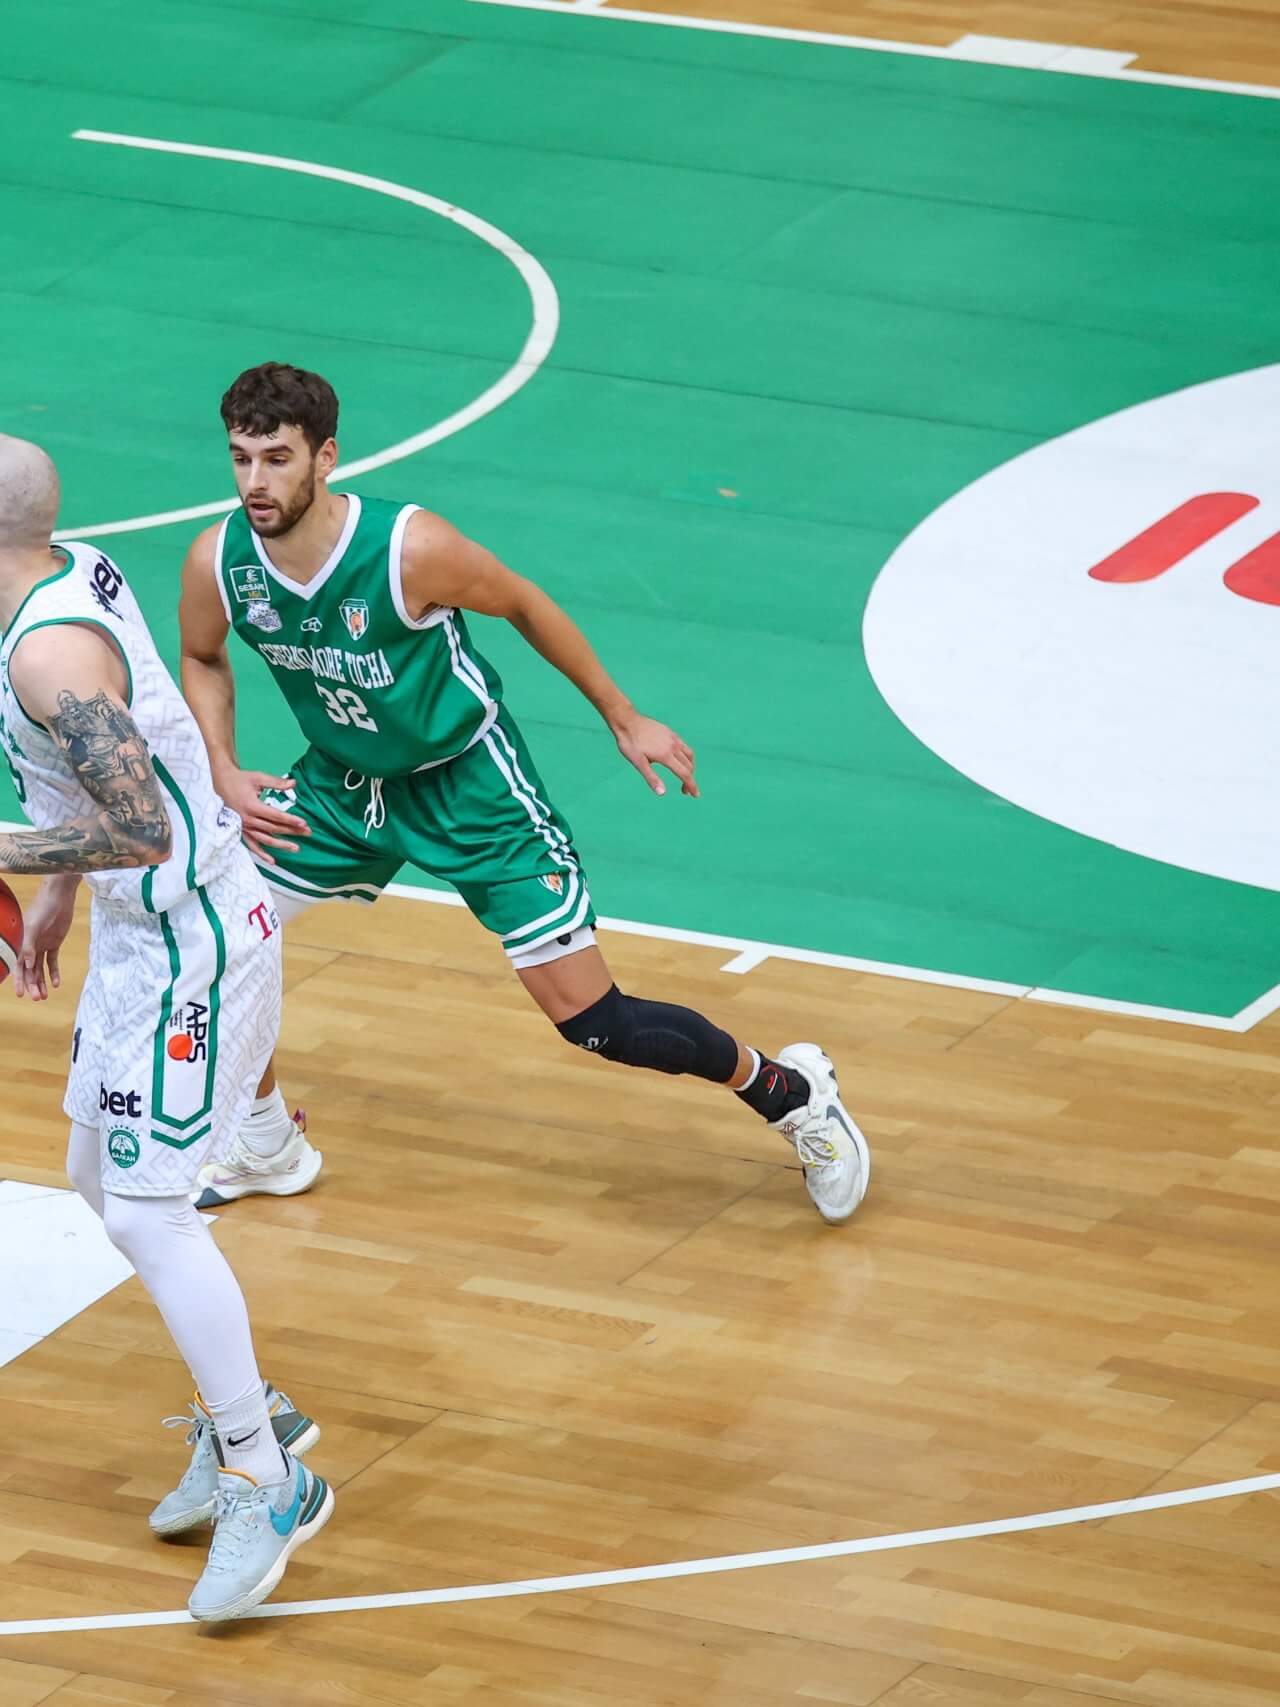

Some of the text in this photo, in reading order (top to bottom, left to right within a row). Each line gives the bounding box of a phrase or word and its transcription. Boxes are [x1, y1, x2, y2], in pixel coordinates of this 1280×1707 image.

[344, 648, 395, 690] TICHA
[314, 681, 379, 734] 32
[186, 1001, 209, 1064] APS
